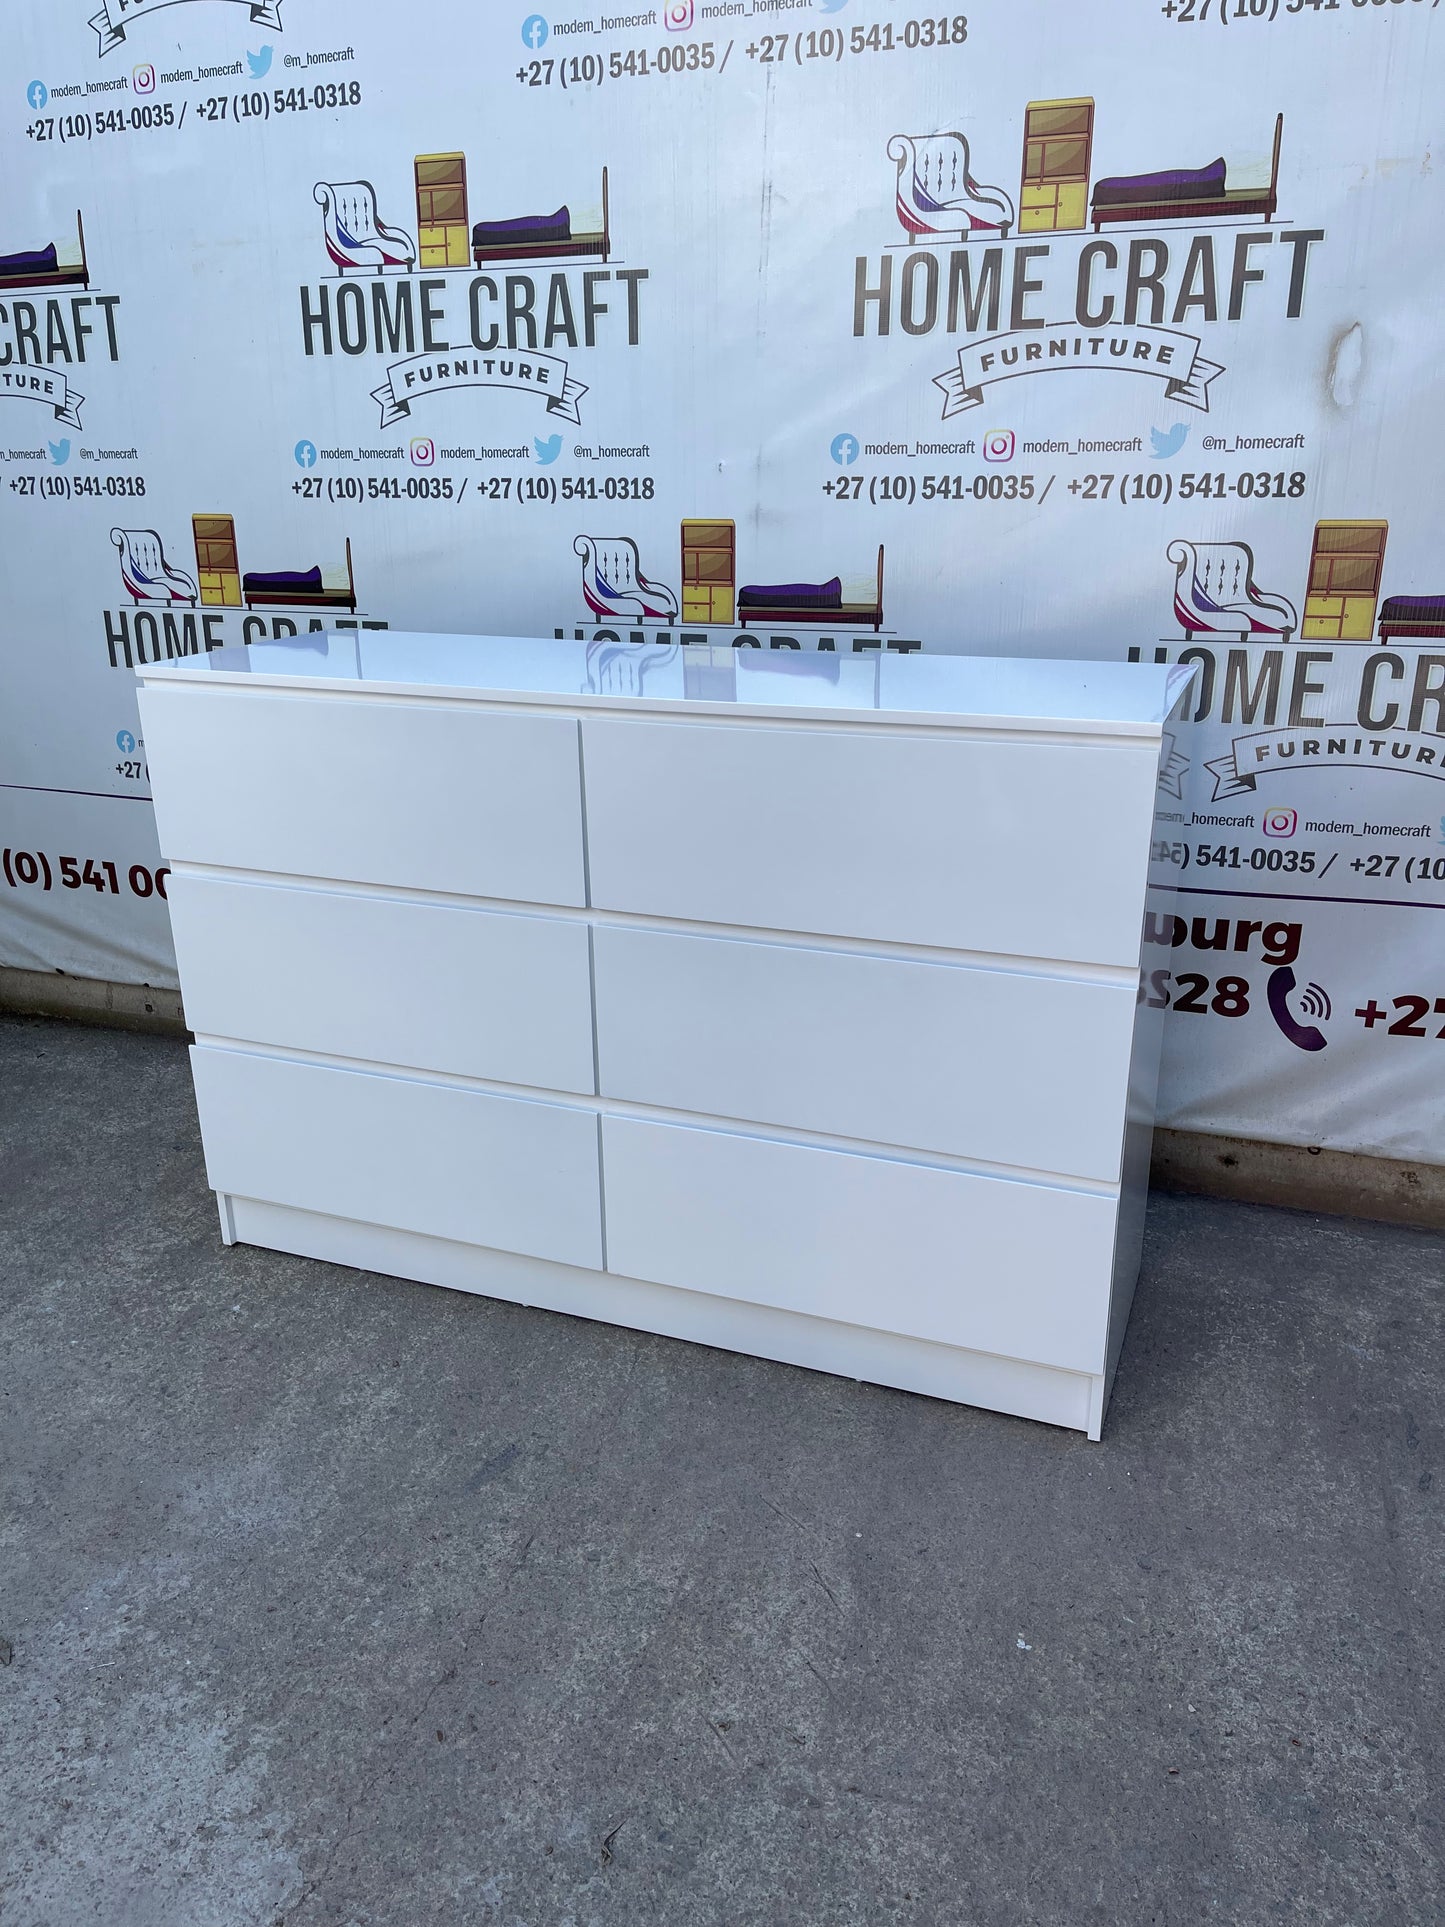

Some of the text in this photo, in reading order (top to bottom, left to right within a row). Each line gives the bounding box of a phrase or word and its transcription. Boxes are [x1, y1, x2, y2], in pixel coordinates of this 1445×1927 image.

[609, 42, 715, 79] 541-0035
[850, 15, 968, 53] 541-0318
[95, 103, 175, 135] 541-0035
[274, 80, 362, 114] 541-0318
[852, 229, 1325, 338] HOME CRAFT
[299, 268, 650, 357] HOME CRAFT
[980, 337, 1176, 373] FURNITURE
[404, 358, 551, 388] FURNITURE
[73, 476, 146, 497] 541-0318
[367, 477, 454, 499] 541-0035
[561, 477, 655, 500] 541-0318
[921, 475, 1035, 500] 541-0035
[1178, 471, 1307, 499] 541-0318
[1128, 646, 1333, 728] OME
[1255, 738, 1445, 768] FURNITUR
[115, 761, 142, 779] +27
[1184, 811, 1255, 828] _homecraft
[3, 848, 53, 891] (0)
[59, 856, 120, 895] 541
[1195, 844, 1316, 874] 541-0035
[1164, 971, 1250, 1018] 28
